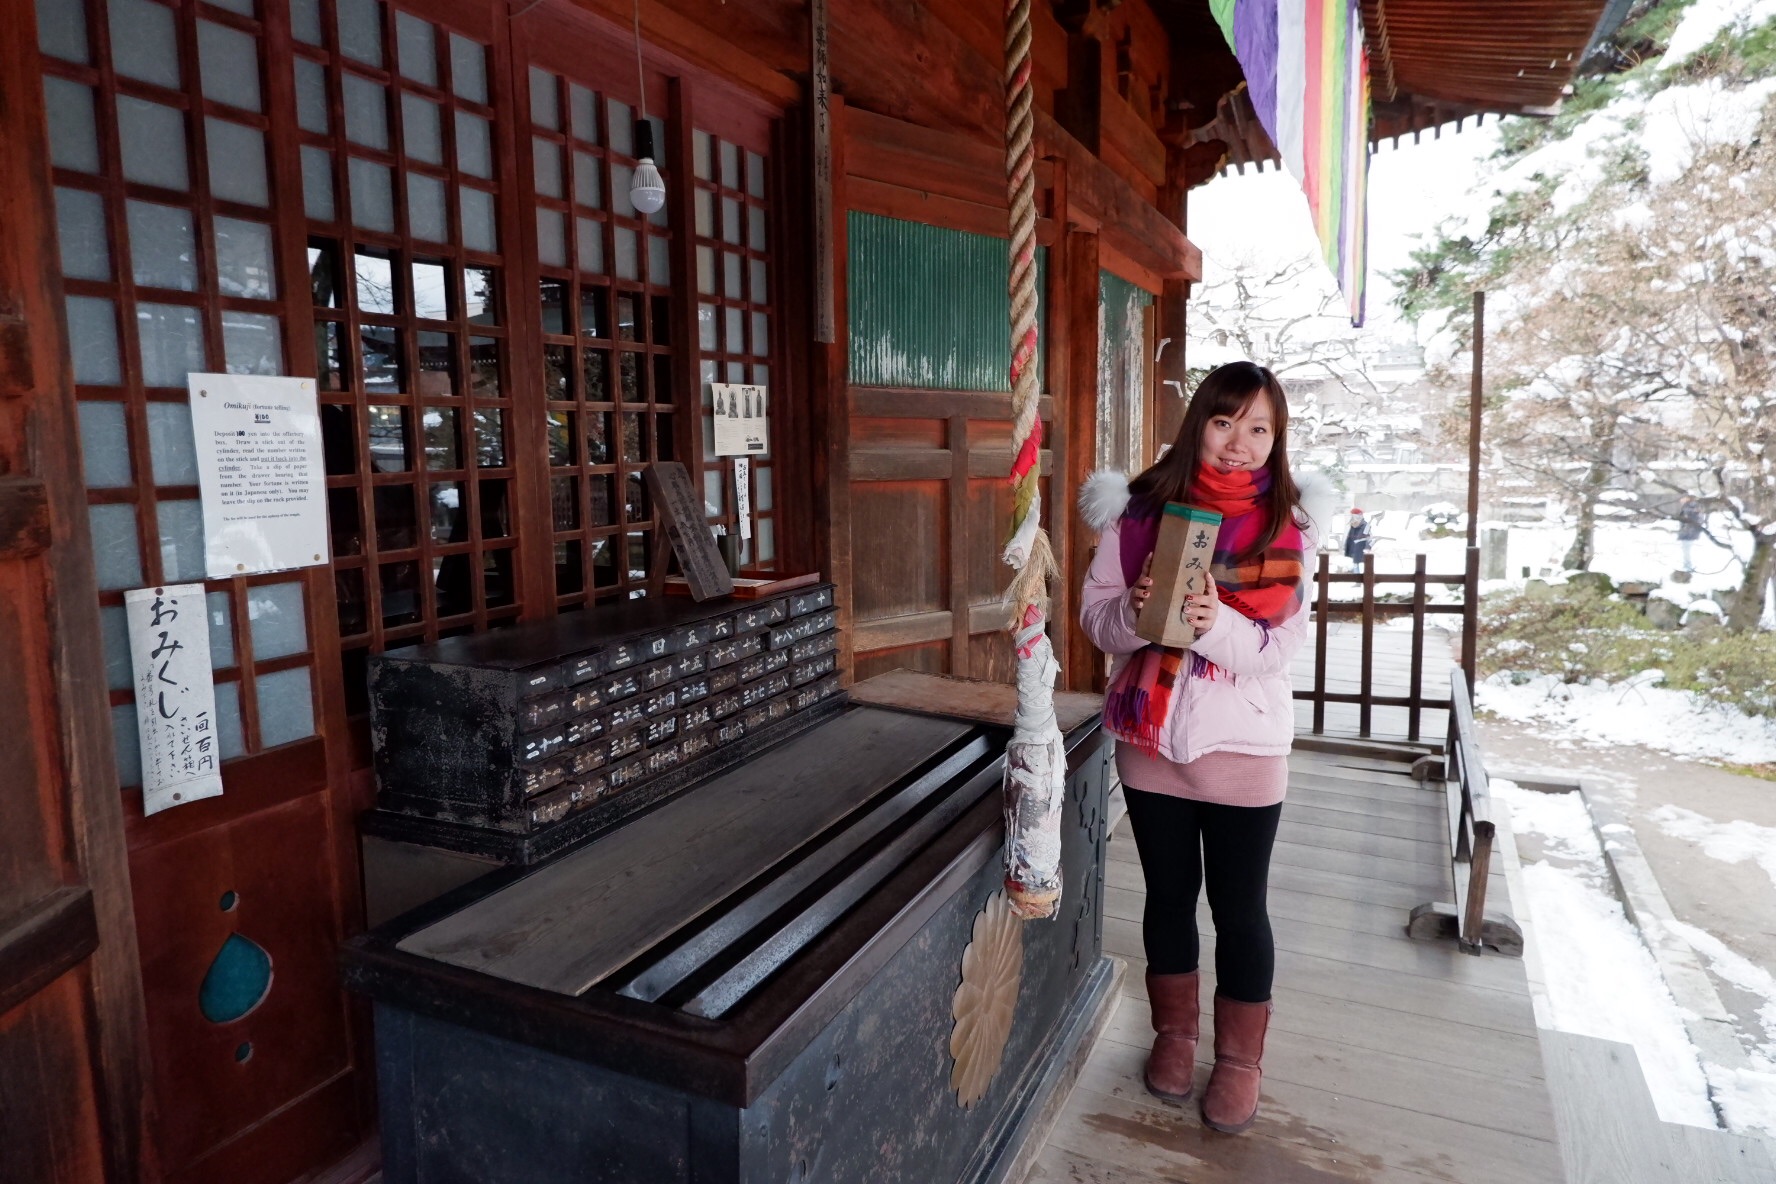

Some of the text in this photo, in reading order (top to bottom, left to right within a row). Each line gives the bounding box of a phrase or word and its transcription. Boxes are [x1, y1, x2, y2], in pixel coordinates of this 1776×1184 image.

[214, 430, 236, 438] Deposit
[223, 401, 251, 411] Omikuji
[150, 596, 190, 719] おみくじ
[530, 591, 826, 686] 一 二 三 四 五 六 七 八 九 十
[572, 690, 601, 711] 十二
[607, 676, 638, 697] 十三
[648, 664, 673, 683] 十四
[679, 654, 704, 672] 十五
[714, 645, 737, 662] 十六
[742, 635, 761, 651] 十七
[774, 629, 793, 645] 十八
[817, 613, 832, 629] 二十
[195, 711, 213, 771] 一回百円
[525, 736, 564, 760] 二十一
[568, 718, 602, 743] 二十二
[611, 703, 643, 726] 二十三
[647, 690, 676, 713] 二十四
[680, 681, 708, 700] 二十五
[766, 651, 789, 671] 二十八
[609, 732, 641, 757] 三十三
[648, 716, 677, 741] 三十四
[742, 685, 766, 707] 三十七
[816, 657, 833, 674] 四十
